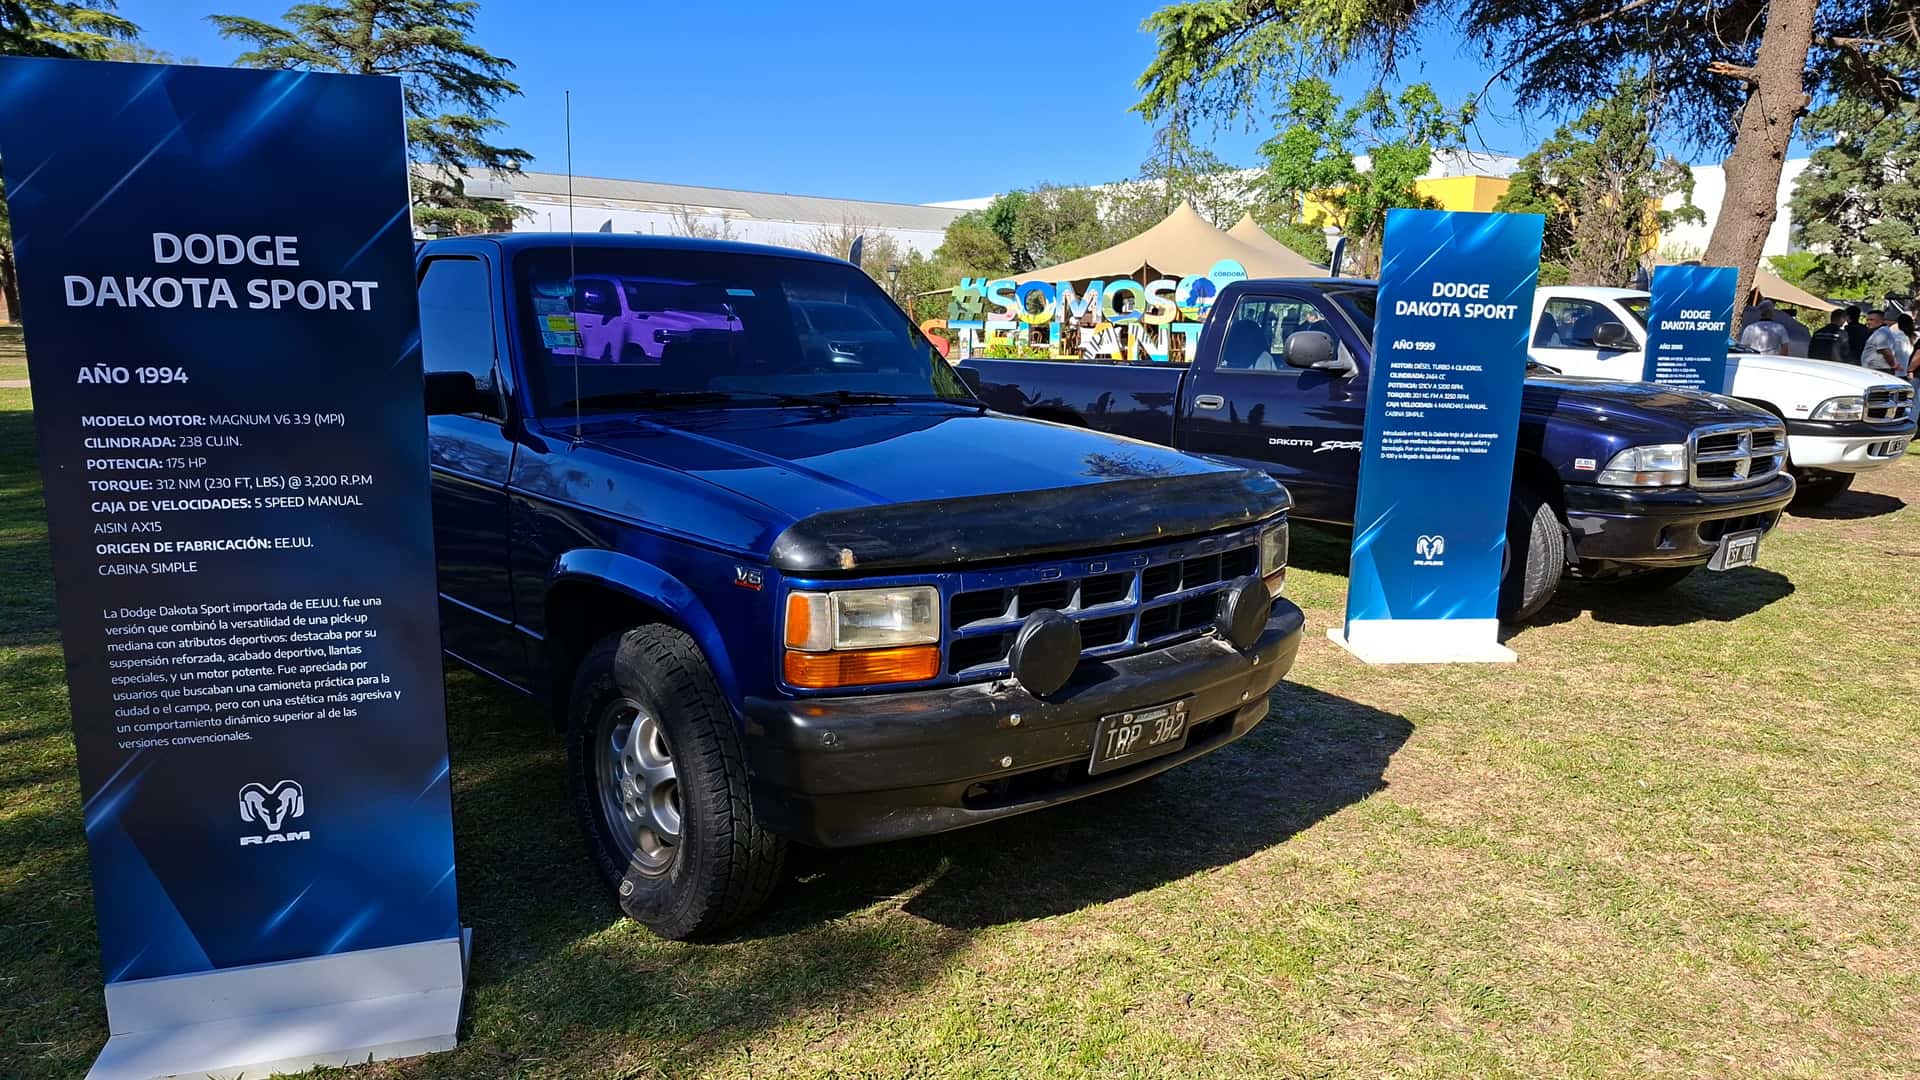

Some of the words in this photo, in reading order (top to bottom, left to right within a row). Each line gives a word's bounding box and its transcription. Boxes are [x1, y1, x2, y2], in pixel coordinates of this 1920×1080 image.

[152, 232, 300, 266] DODGE
[64, 275, 238, 309] DAKOTA
[246, 279, 378, 311] SPORT
[1432, 282, 1490, 298] DODGE
[1395, 300, 1461, 318] DAKOTA
[1464, 303, 1518, 320] SPORT
[1680, 310, 1711, 319] DODGE
[1661, 321, 1695, 330] DAKOTA
[1697, 322, 1726, 331] SPORT
[1392, 339, 1413, 350] AÑO
[1415, 341, 1436, 350] 1999
[77, 363, 130, 384] AÑO
[135, 366, 189, 384] 1994
[81, 415, 145, 427] MODELO
[148, 415, 206, 426] MOTOR:
[209, 414, 271, 426] MAGNUM
[273, 414, 291, 425] V6
[293, 413, 311, 425] 3.9
[314, 413, 345, 427] (MPI)
[84, 436, 176, 449] CILINDRADA:
[179, 436, 203, 447] 238
[205, 435, 242, 447] CU.IN.
[1268, 438, 1313, 446] DAKOTA
[1313, 441, 1363, 453] SPOR
[86, 458, 163, 470] POTENCIA:
[165, 457, 185, 468] 175
[188, 457, 207, 468] HP
[87, 479, 153, 492] TORQUE:
[156, 478, 176, 490] 312
[178, 478, 201, 489] NM
[204, 477, 231, 491] (230
[234, 477, 253, 489] FT,
[255, 475, 285, 490] LBS.)
[288, 475, 302, 490] @
[304, 475, 337, 488] 3,200
[340, 474, 373, 486] R.P.M
[91, 501, 126, 514] CAJA
[128, 500, 149, 512] DE
[151, 497, 252, 511] VELOCIDADES:
[254, 497, 262, 509] 5
[264, 496, 305, 508] SPEED
[307, 495, 363, 507] MANUAL
[94, 522, 128, 534] AISIN
[131, 521, 162, 533] AX15
[96, 542, 150, 555] ORIGEN
[153, 541, 173, 553] DE
[176, 536, 272, 552] FABRICACIÓN:
[274, 536, 314, 549] EE.UU.
[98, 563, 149, 576] CABINA
[151, 561, 198, 574] SIMPLE
[735, 565, 761, 584] V6
[103, 609, 118, 619] La
[120, 607, 157, 620] Dodge
[159, 605, 198, 616] Dakota
[200, 603, 231, 616] Sport
[232, 599, 287, 614] importada
[289, 599, 303, 610] de
[305, 597, 341, 609] EE.UU.
[342, 596, 361, 607] fue
[362, 597, 382, 606] una
[105, 623, 145, 635] versión
[147, 624, 169, 635] que
[170, 619, 217, 632] combinó
[218, 619, 228, 630] la
[230, 615, 291, 629] versatilidad
[292, 615, 306, 626] de
[308, 616, 328, 625] una
[330, 612, 368, 626] pick-up
[107, 640, 154, 651] mediana
[156, 640, 176, 649] con
[178, 637, 227, 648] atributos
[228, 633, 288, 647] deportivos:
[289, 629, 343, 642] destacaba
[344, 630, 363, 641] por
[364, 629, 377, 638] su
[109, 655, 169, 669] suspensión
[171, 651, 226, 665] reforzada,
[227, 649, 272, 662] acabado
[273, 647, 327, 660] deportivo,
[328, 645, 362, 656] llantas
[111, 672, 168, 686] especiales,
[169, 673, 177, 683] y
[179, 672, 194, 681] un
[196, 669, 229, 679] motor
[231, 666, 275, 680] potente.
[277, 664, 297, 674] Fue
[299, 660, 348, 675] apreciada
[349, 661, 368, 672] por
[113, 689, 158, 701] usuarios
[160, 689, 181, 699] que
[183, 684, 234, 696] buscaban
[235, 684, 256, 693] una
[257, 679, 312, 692] camioneta
[314, 676, 354, 690] práctica
[356, 676, 379, 687] para
[380, 673, 390, 684] la
[114, 705, 150, 717] ciudad
[152, 706, 160, 714] o
[162, 703, 172, 714] el
[174, 703, 213, 713] campo,
[215, 701, 239, 712] pero
[241, 699, 260, 709] con
[262, 698, 282, 707] una
[284, 694, 325, 706] estética
[326, 691, 349, 702] más
[350, 689, 392, 703] agresiva
[393, 690, 401, 700] y
[116, 725, 131, 733] un
[133, 717, 222, 733] comportamiento
[224, 713, 271, 726] dinámico
[272, 710, 315, 724] superior
[316, 708, 326, 719] al
[327, 707, 341, 718] de
[343, 706, 357, 717] las
[118, 738, 170, 749] versiones
[171, 730, 253, 745] convencionales.
[240, 831, 310, 845] RAM
